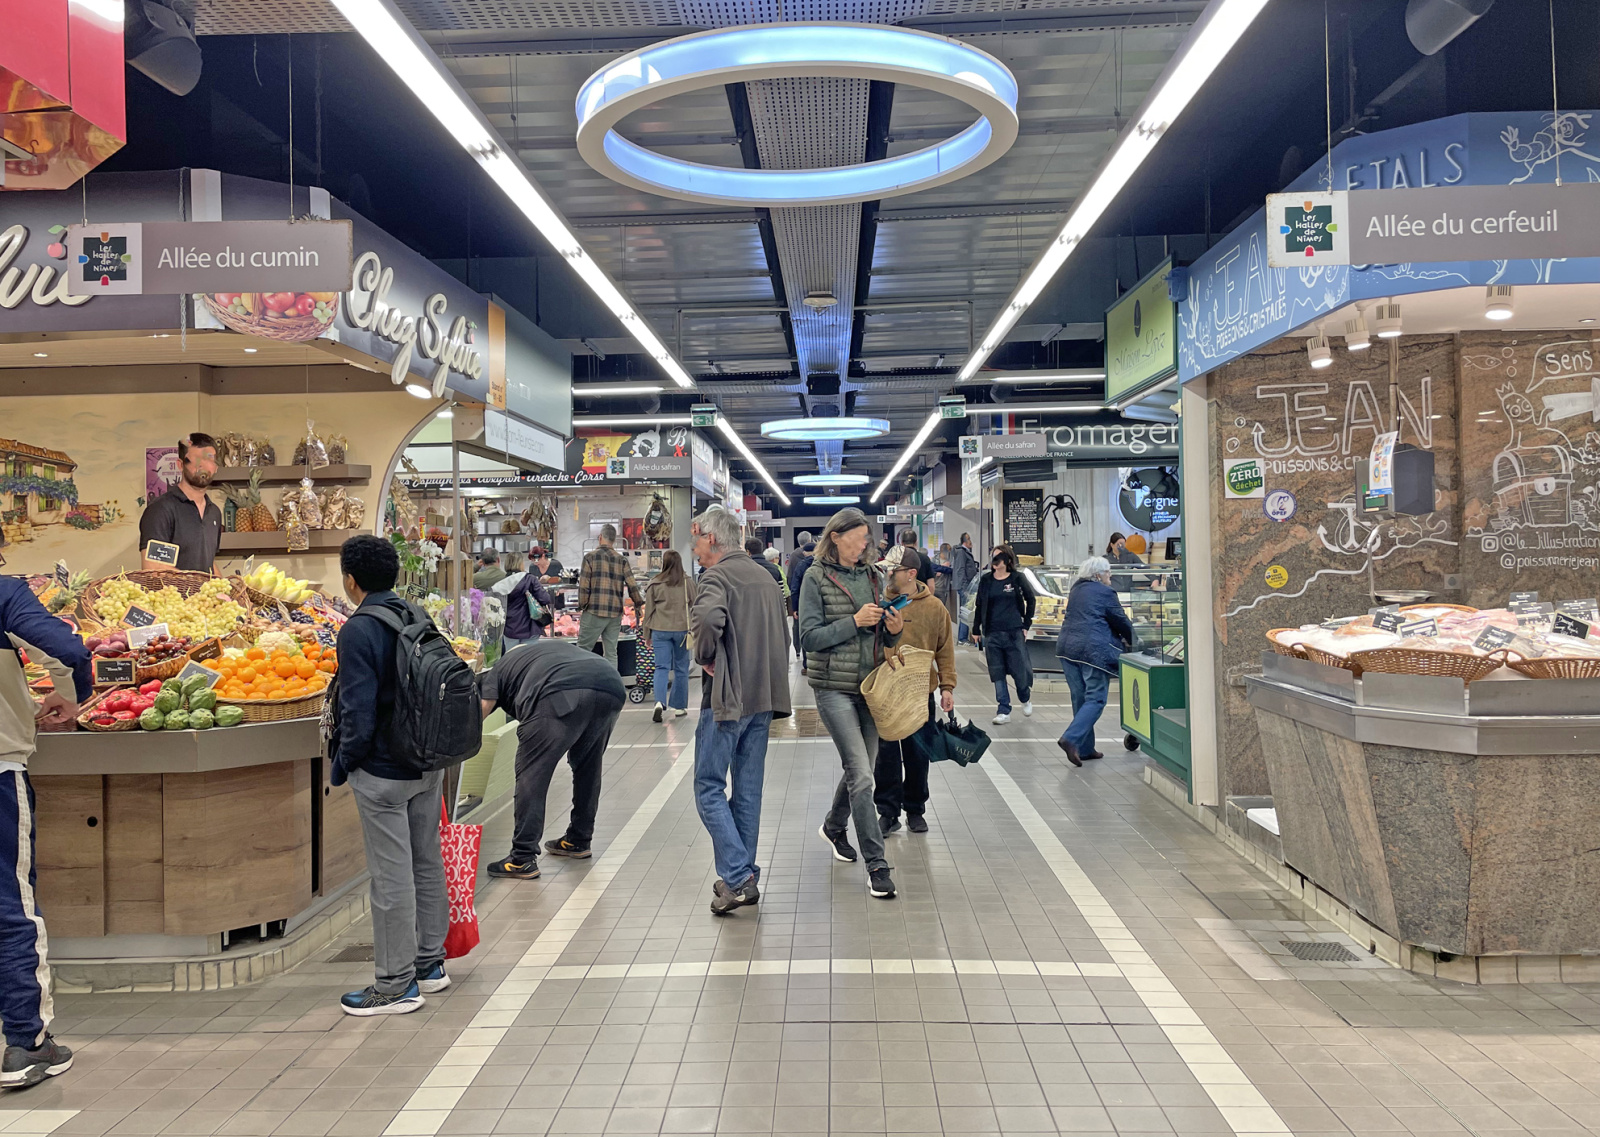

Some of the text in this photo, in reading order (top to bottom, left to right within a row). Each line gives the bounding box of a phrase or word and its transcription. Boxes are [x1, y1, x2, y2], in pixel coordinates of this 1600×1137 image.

[1365, 209, 1559, 238] Allée du cerfeuil
[157, 246, 319, 269] Allée du cumin
[1213, 232, 1286, 331] JEAN
[346, 251, 483, 398] Chez Sylvie
[1251, 377, 1432, 458] JEAN
[987, 441, 1036, 450] Allée du safran
[169, 462, 176, 470] 31
[633, 463, 651, 471] Allée
[651, 463, 660, 471] du
[660, 463, 681, 471] safran
[574, 471, 604, 484] Corse
[1235, 479, 1262, 491] déchet
